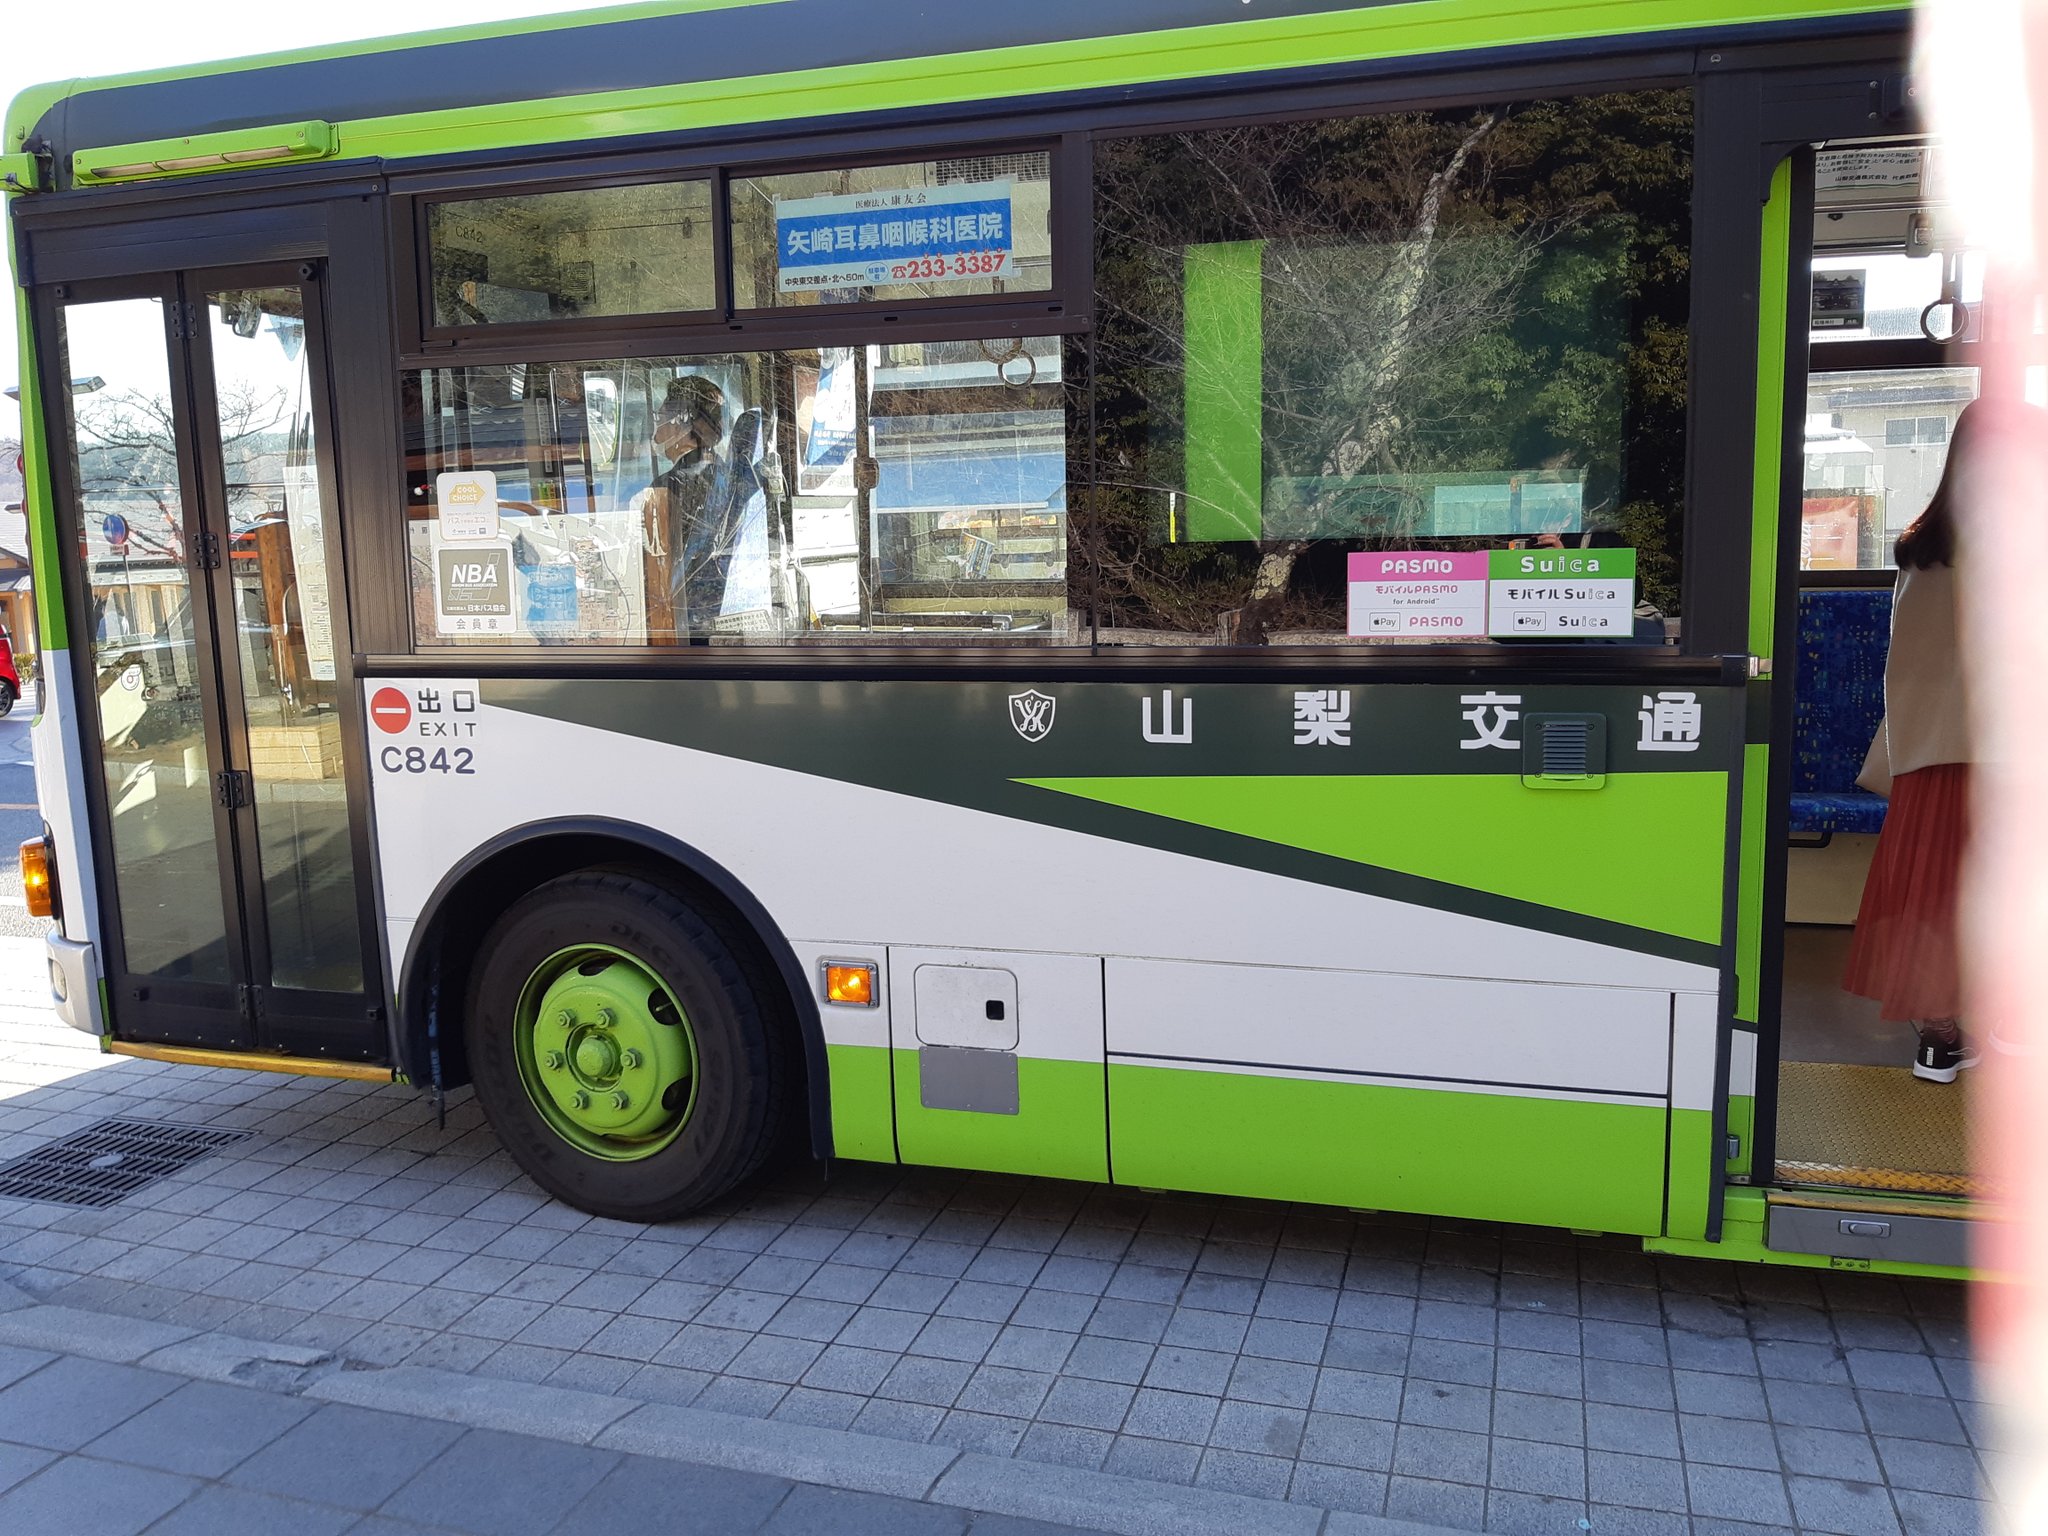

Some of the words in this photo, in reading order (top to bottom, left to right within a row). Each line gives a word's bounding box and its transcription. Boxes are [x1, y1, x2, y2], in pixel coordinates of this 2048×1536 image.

[787, 212, 1003, 256] 矢崎耳鼻咽喉科医院
[452, 493, 479, 502] CHOICE
[457, 486, 477, 494] COOL
[1381, 559, 1453, 575] PASMO
[1520, 556, 1600, 573] Suica
[451, 563, 498, 583] NBA
[1375, 584, 1458, 594] モバイルPASMO
[467, 604, 506, 612] 日本バス協会
[456, 618, 498, 630] 会員章
[1380, 617, 1396, 627] Pay
[1409, 616, 1463, 627] PASMO
[1525, 616, 1542, 626] Pay
[1558, 615, 1609, 627] Suica
[418, 687, 475, 713] 出口
[1141, 689, 1701, 752] 山梨交通
[419, 722, 477, 737] EXIT
[380, 746, 476, 774] C842
